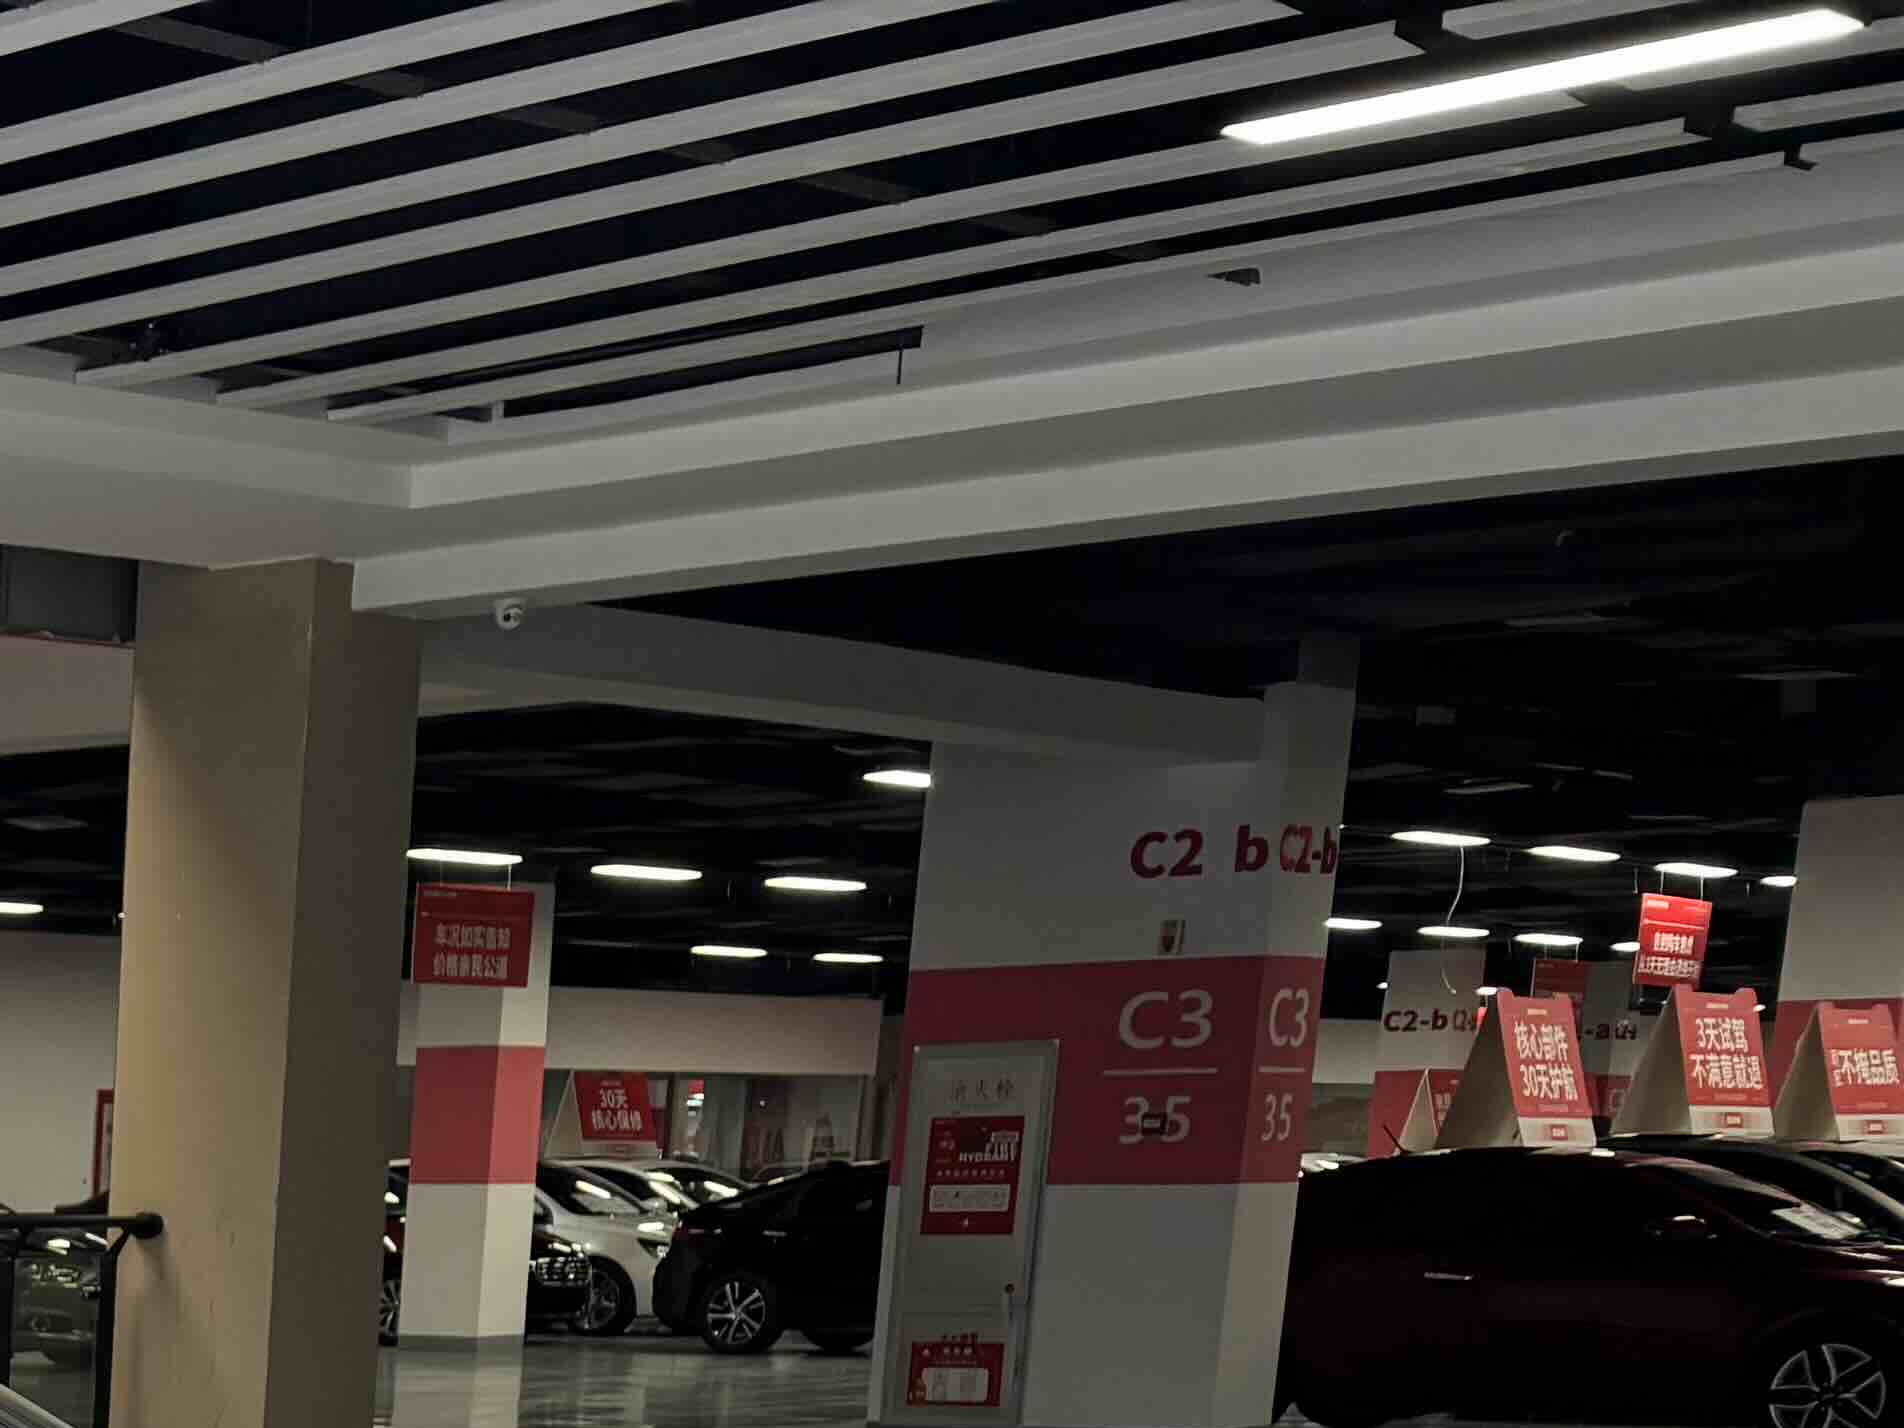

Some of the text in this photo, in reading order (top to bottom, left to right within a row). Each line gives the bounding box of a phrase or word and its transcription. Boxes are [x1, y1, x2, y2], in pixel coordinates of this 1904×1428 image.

[1129, 829, 1204, 878] C2
[1279, 824, 1337, 873] C2-b
[1118, 988, 1214, 1050] C3
[1268, 987, 1310, 1048] C3
[1384, 1010, 1448, 1032] C2-b
[1514, 1019, 1569, 1062] 核心部件
[1695, 1016, 1749, 1053] 3天试驾
[1689, 1053, 1763, 1090] 不满意就退
[1260, 1092, 1294, 1143] 35
